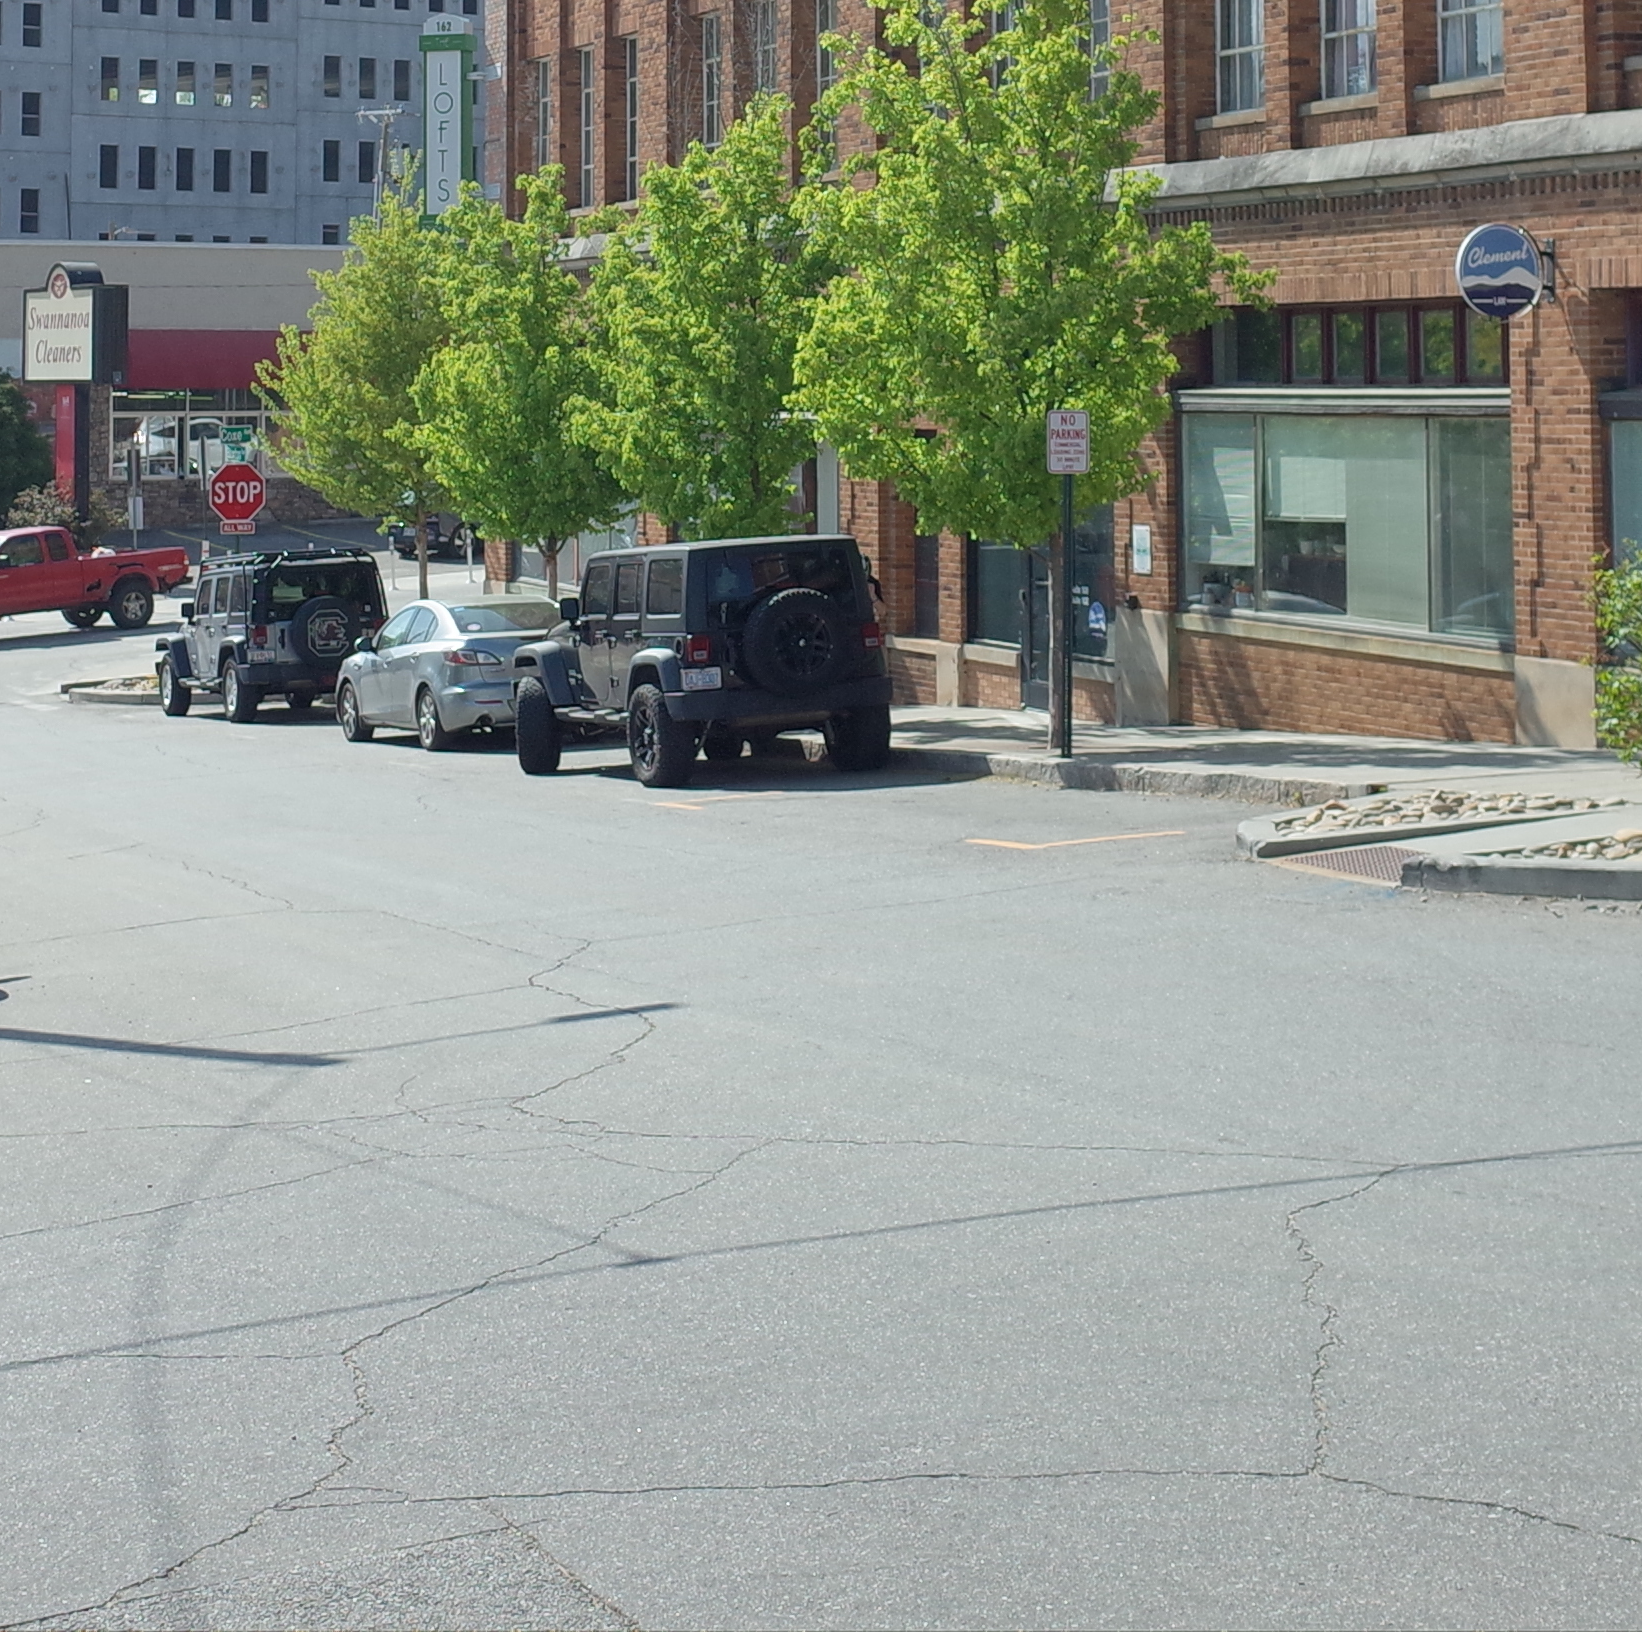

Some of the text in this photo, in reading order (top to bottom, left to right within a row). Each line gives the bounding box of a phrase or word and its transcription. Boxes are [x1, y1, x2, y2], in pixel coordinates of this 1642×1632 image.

[436, 21, 452, 32] 162
[433, 62, 454, 203] LOFTS
[1467, 241, 1528, 268] Clement
[28, 306, 89, 330] Swannanoa
[35, 339, 81, 364] Cleaners
[1061, 414, 1075, 426] NO
[1050, 428, 1086, 439] PARKING
[214, 481, 261, 504] STOP
[223, 523, 252, 532] ALL WAY
